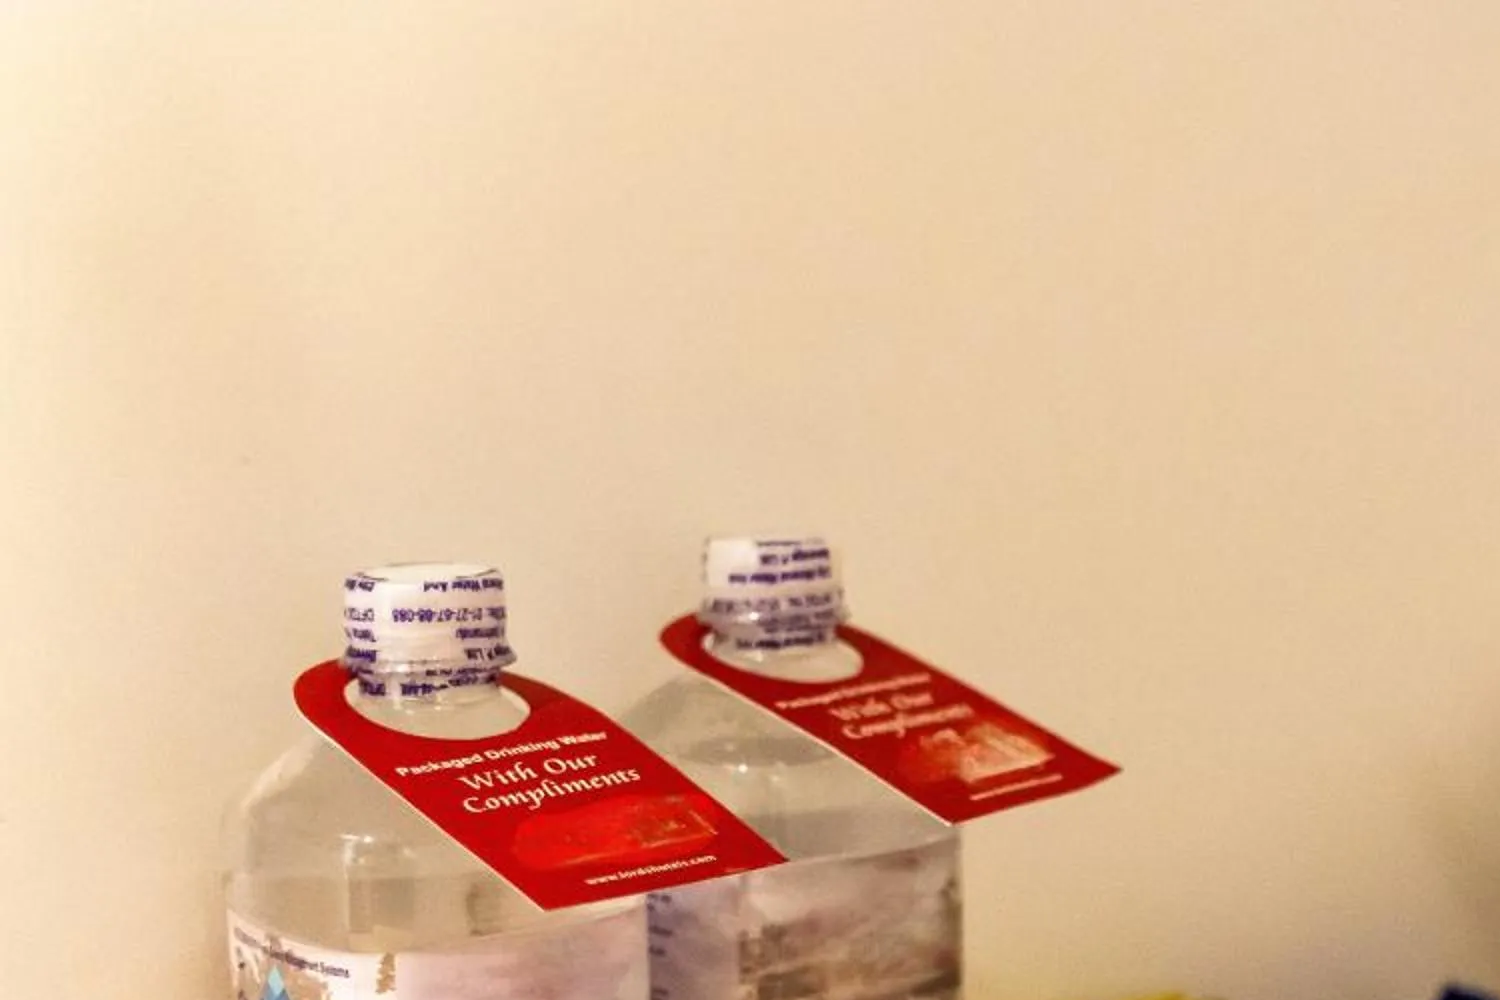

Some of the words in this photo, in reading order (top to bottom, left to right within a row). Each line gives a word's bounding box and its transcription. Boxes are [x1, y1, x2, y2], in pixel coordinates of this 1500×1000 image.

[394, 753, 483, 777] Packaged
[483, 740, 560, 760] Drinking
[558, 731, 609, 746] Water
[456, 761, 539, 791] With
[542, 754, 598, 775] Our
[462, 767, 641, 813] Compliments
